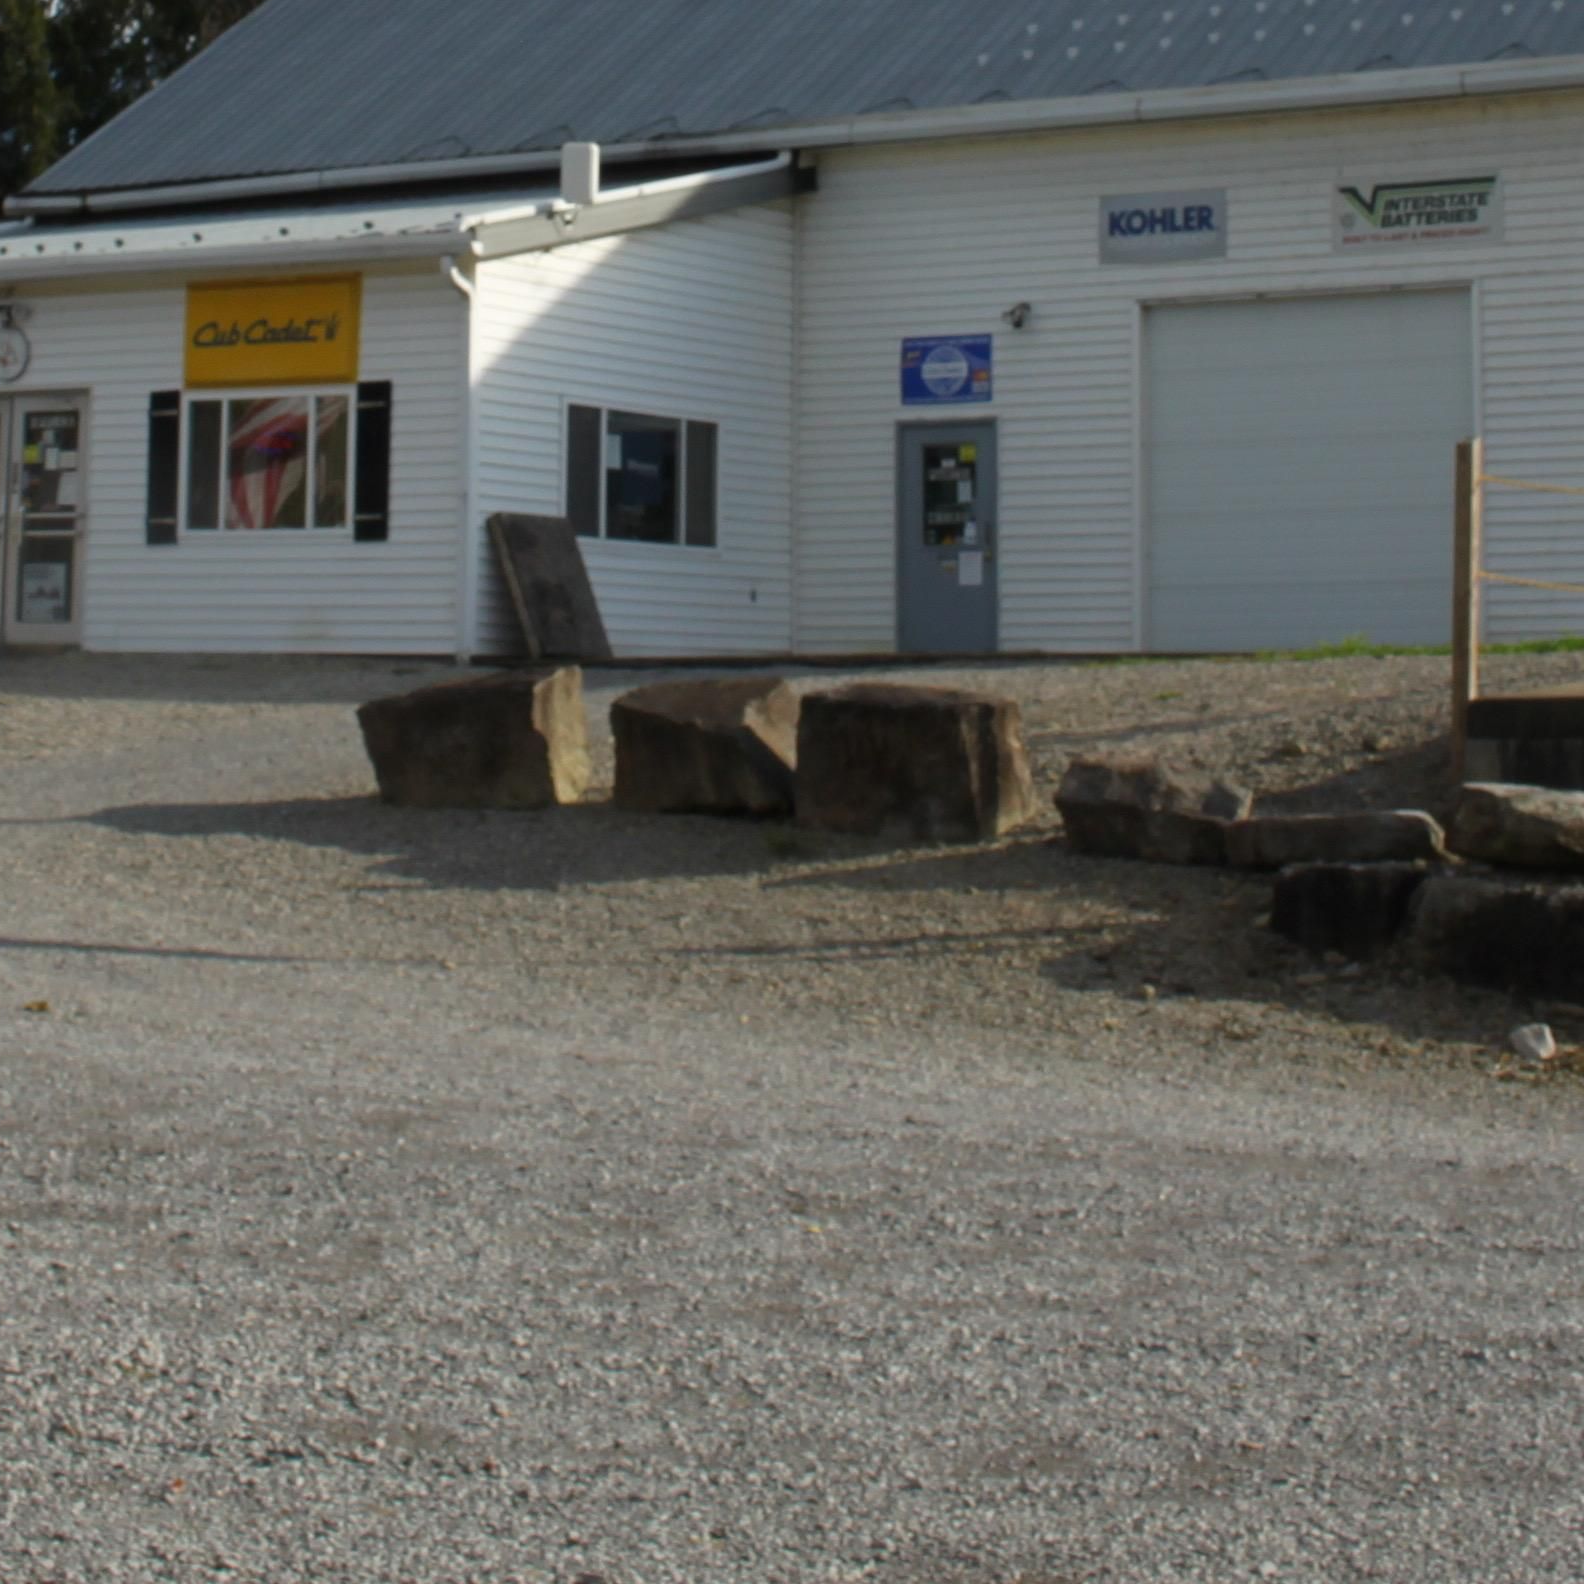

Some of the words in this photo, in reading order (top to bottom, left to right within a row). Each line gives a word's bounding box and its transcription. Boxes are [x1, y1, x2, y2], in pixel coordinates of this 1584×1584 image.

[1383, 192, 1490, 212] INTERSTATE
[1108, 204, 1216, 237] KOHLER
[1380, 208, 1479, 229] BATTERIES
[193, 319, 240, 347] Cub
[244, 316, 319, 345] Cadet
